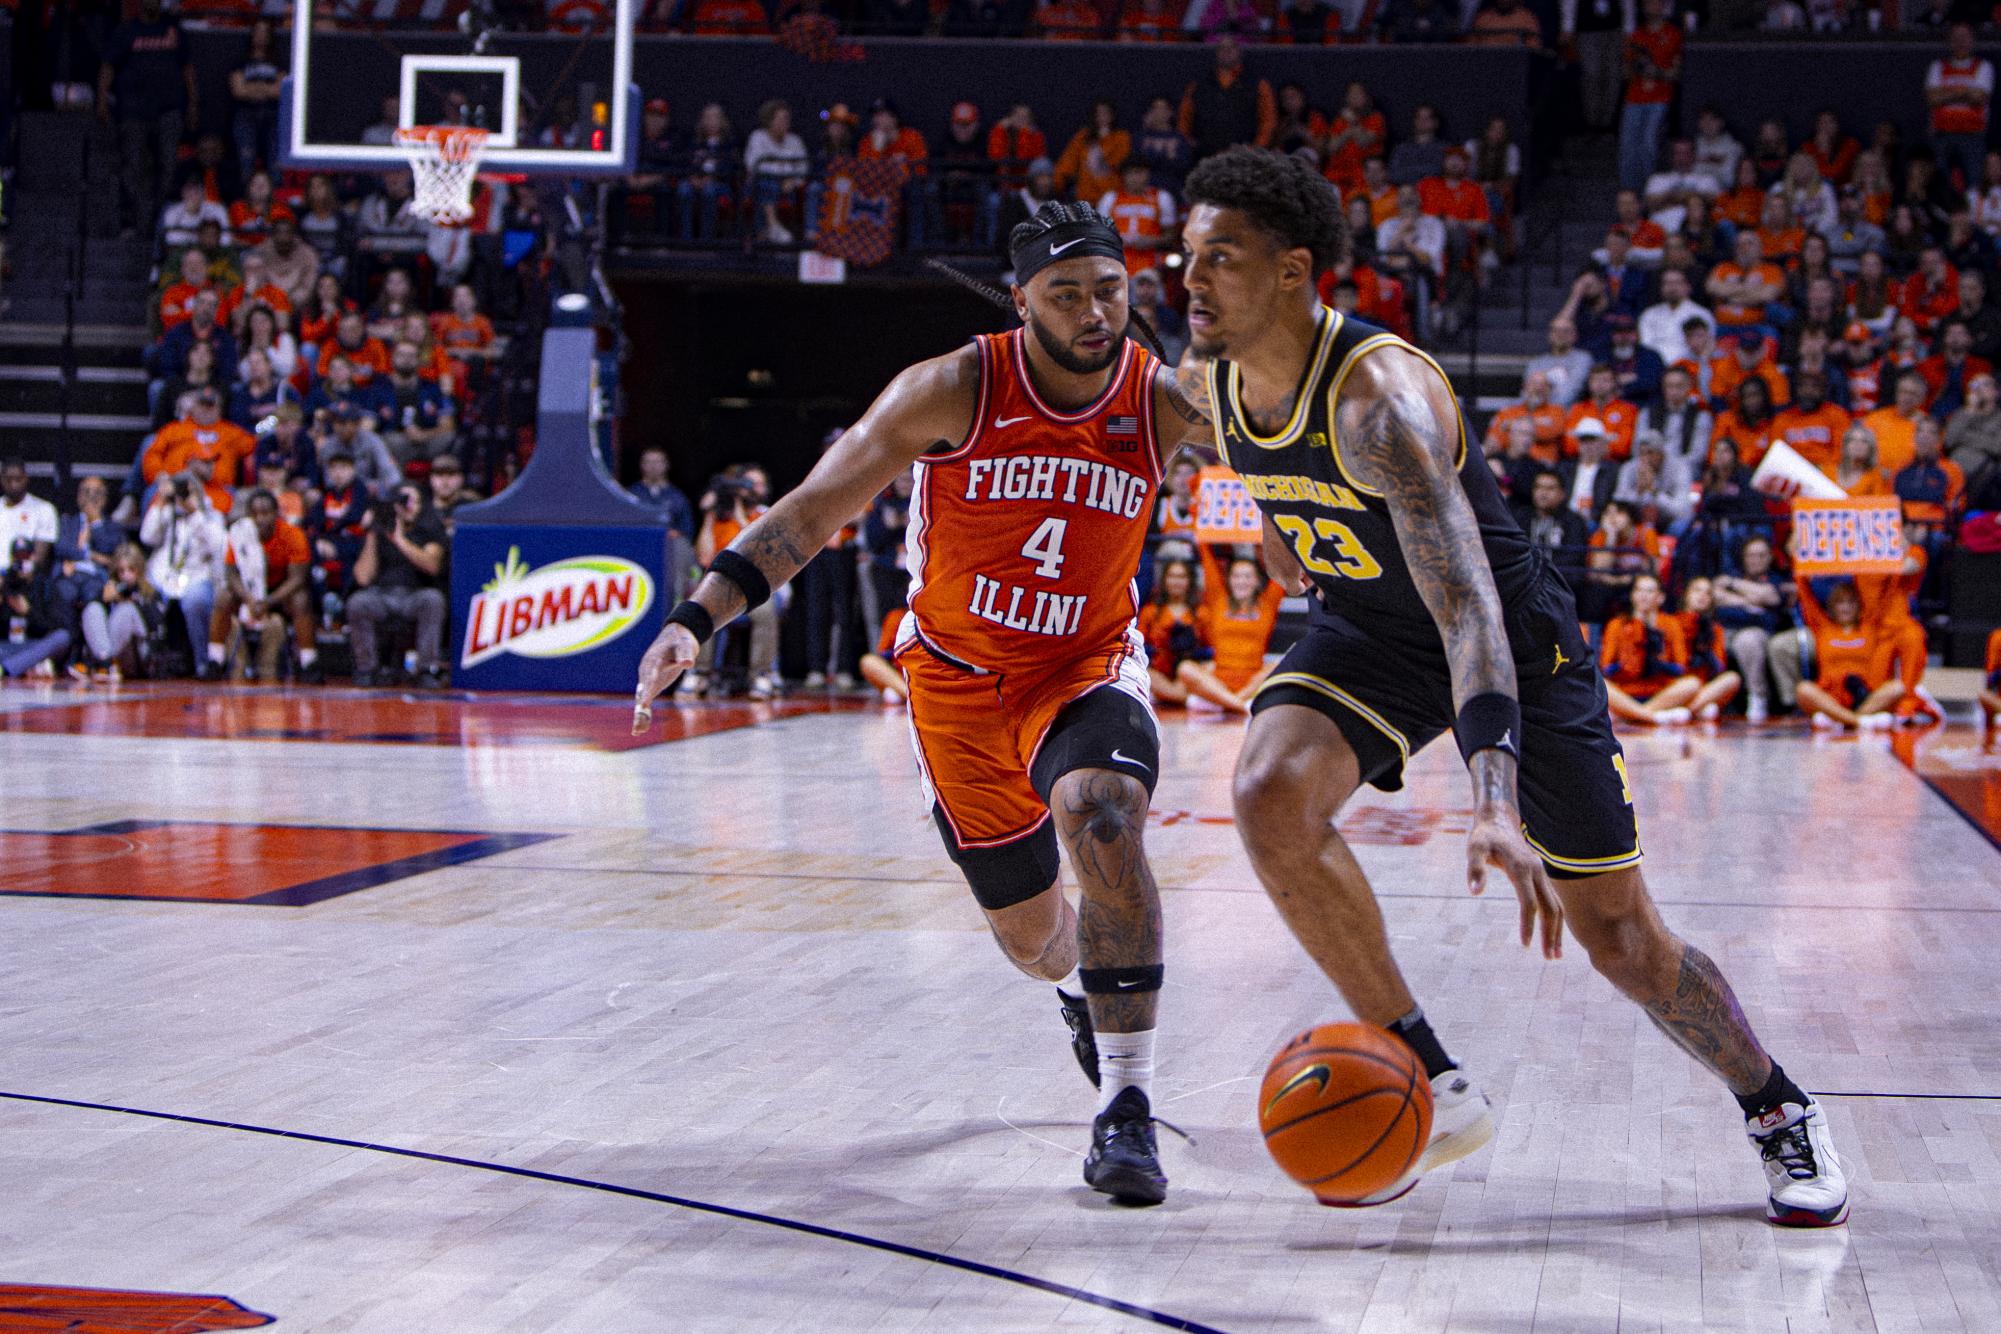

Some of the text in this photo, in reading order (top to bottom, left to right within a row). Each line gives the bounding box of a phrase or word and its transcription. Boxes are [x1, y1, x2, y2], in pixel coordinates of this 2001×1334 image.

[965, 455, 1148, 520] FIGHTING
[1020, 516, 1069, 580] 4
[1273, 513, 1383, 580] 23
[1795, 510, 1903, 561] DEFENSE
[469, 574, 634, 656] LIBMAN
[968, 574, 1087, 637] ILLINI
